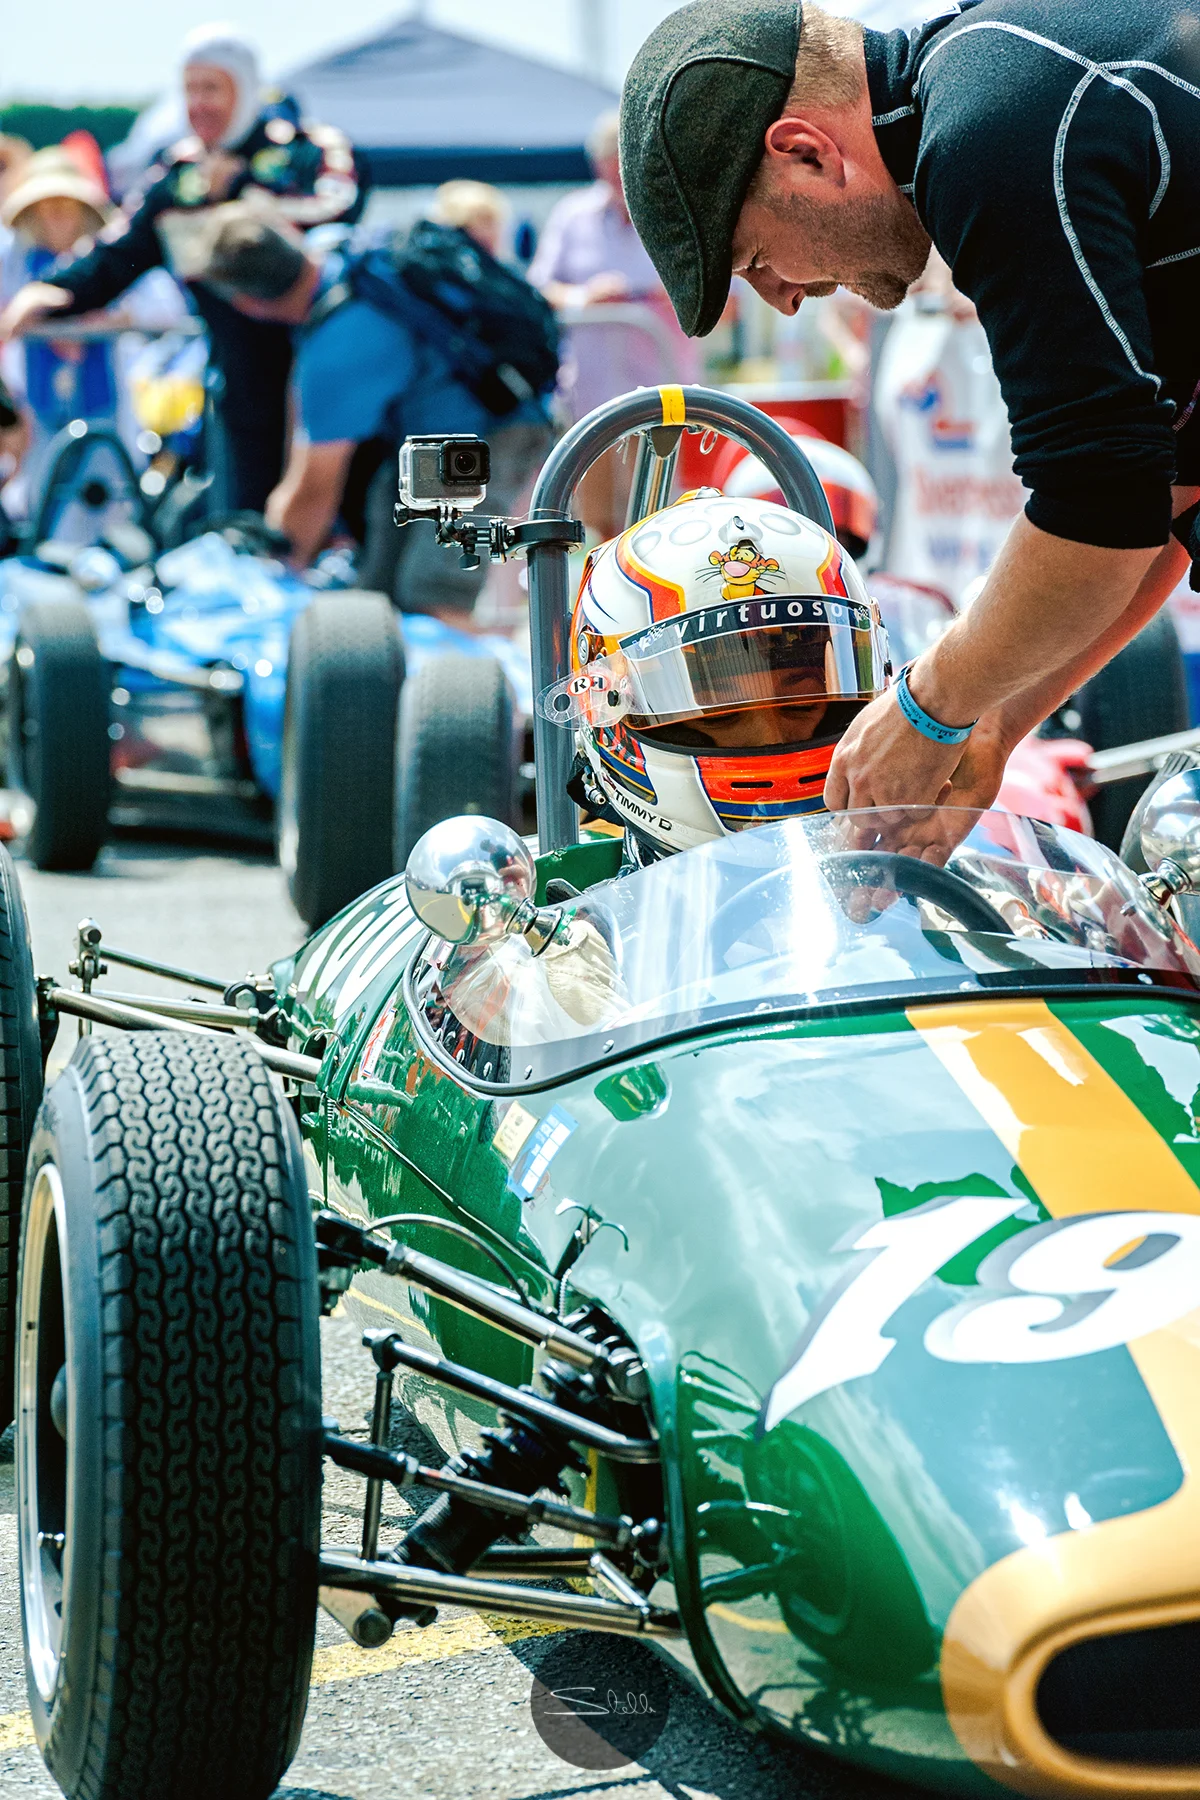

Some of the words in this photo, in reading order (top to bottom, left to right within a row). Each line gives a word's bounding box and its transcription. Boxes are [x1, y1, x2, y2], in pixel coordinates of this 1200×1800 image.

[673, 601, 843, 638] virtuoso
[574, 678, 586, 693] R
[615, 789, 657, 823] TIMMY
[658, 817, 673, 831] D
[757, 1195, 1200, 1438] 19
